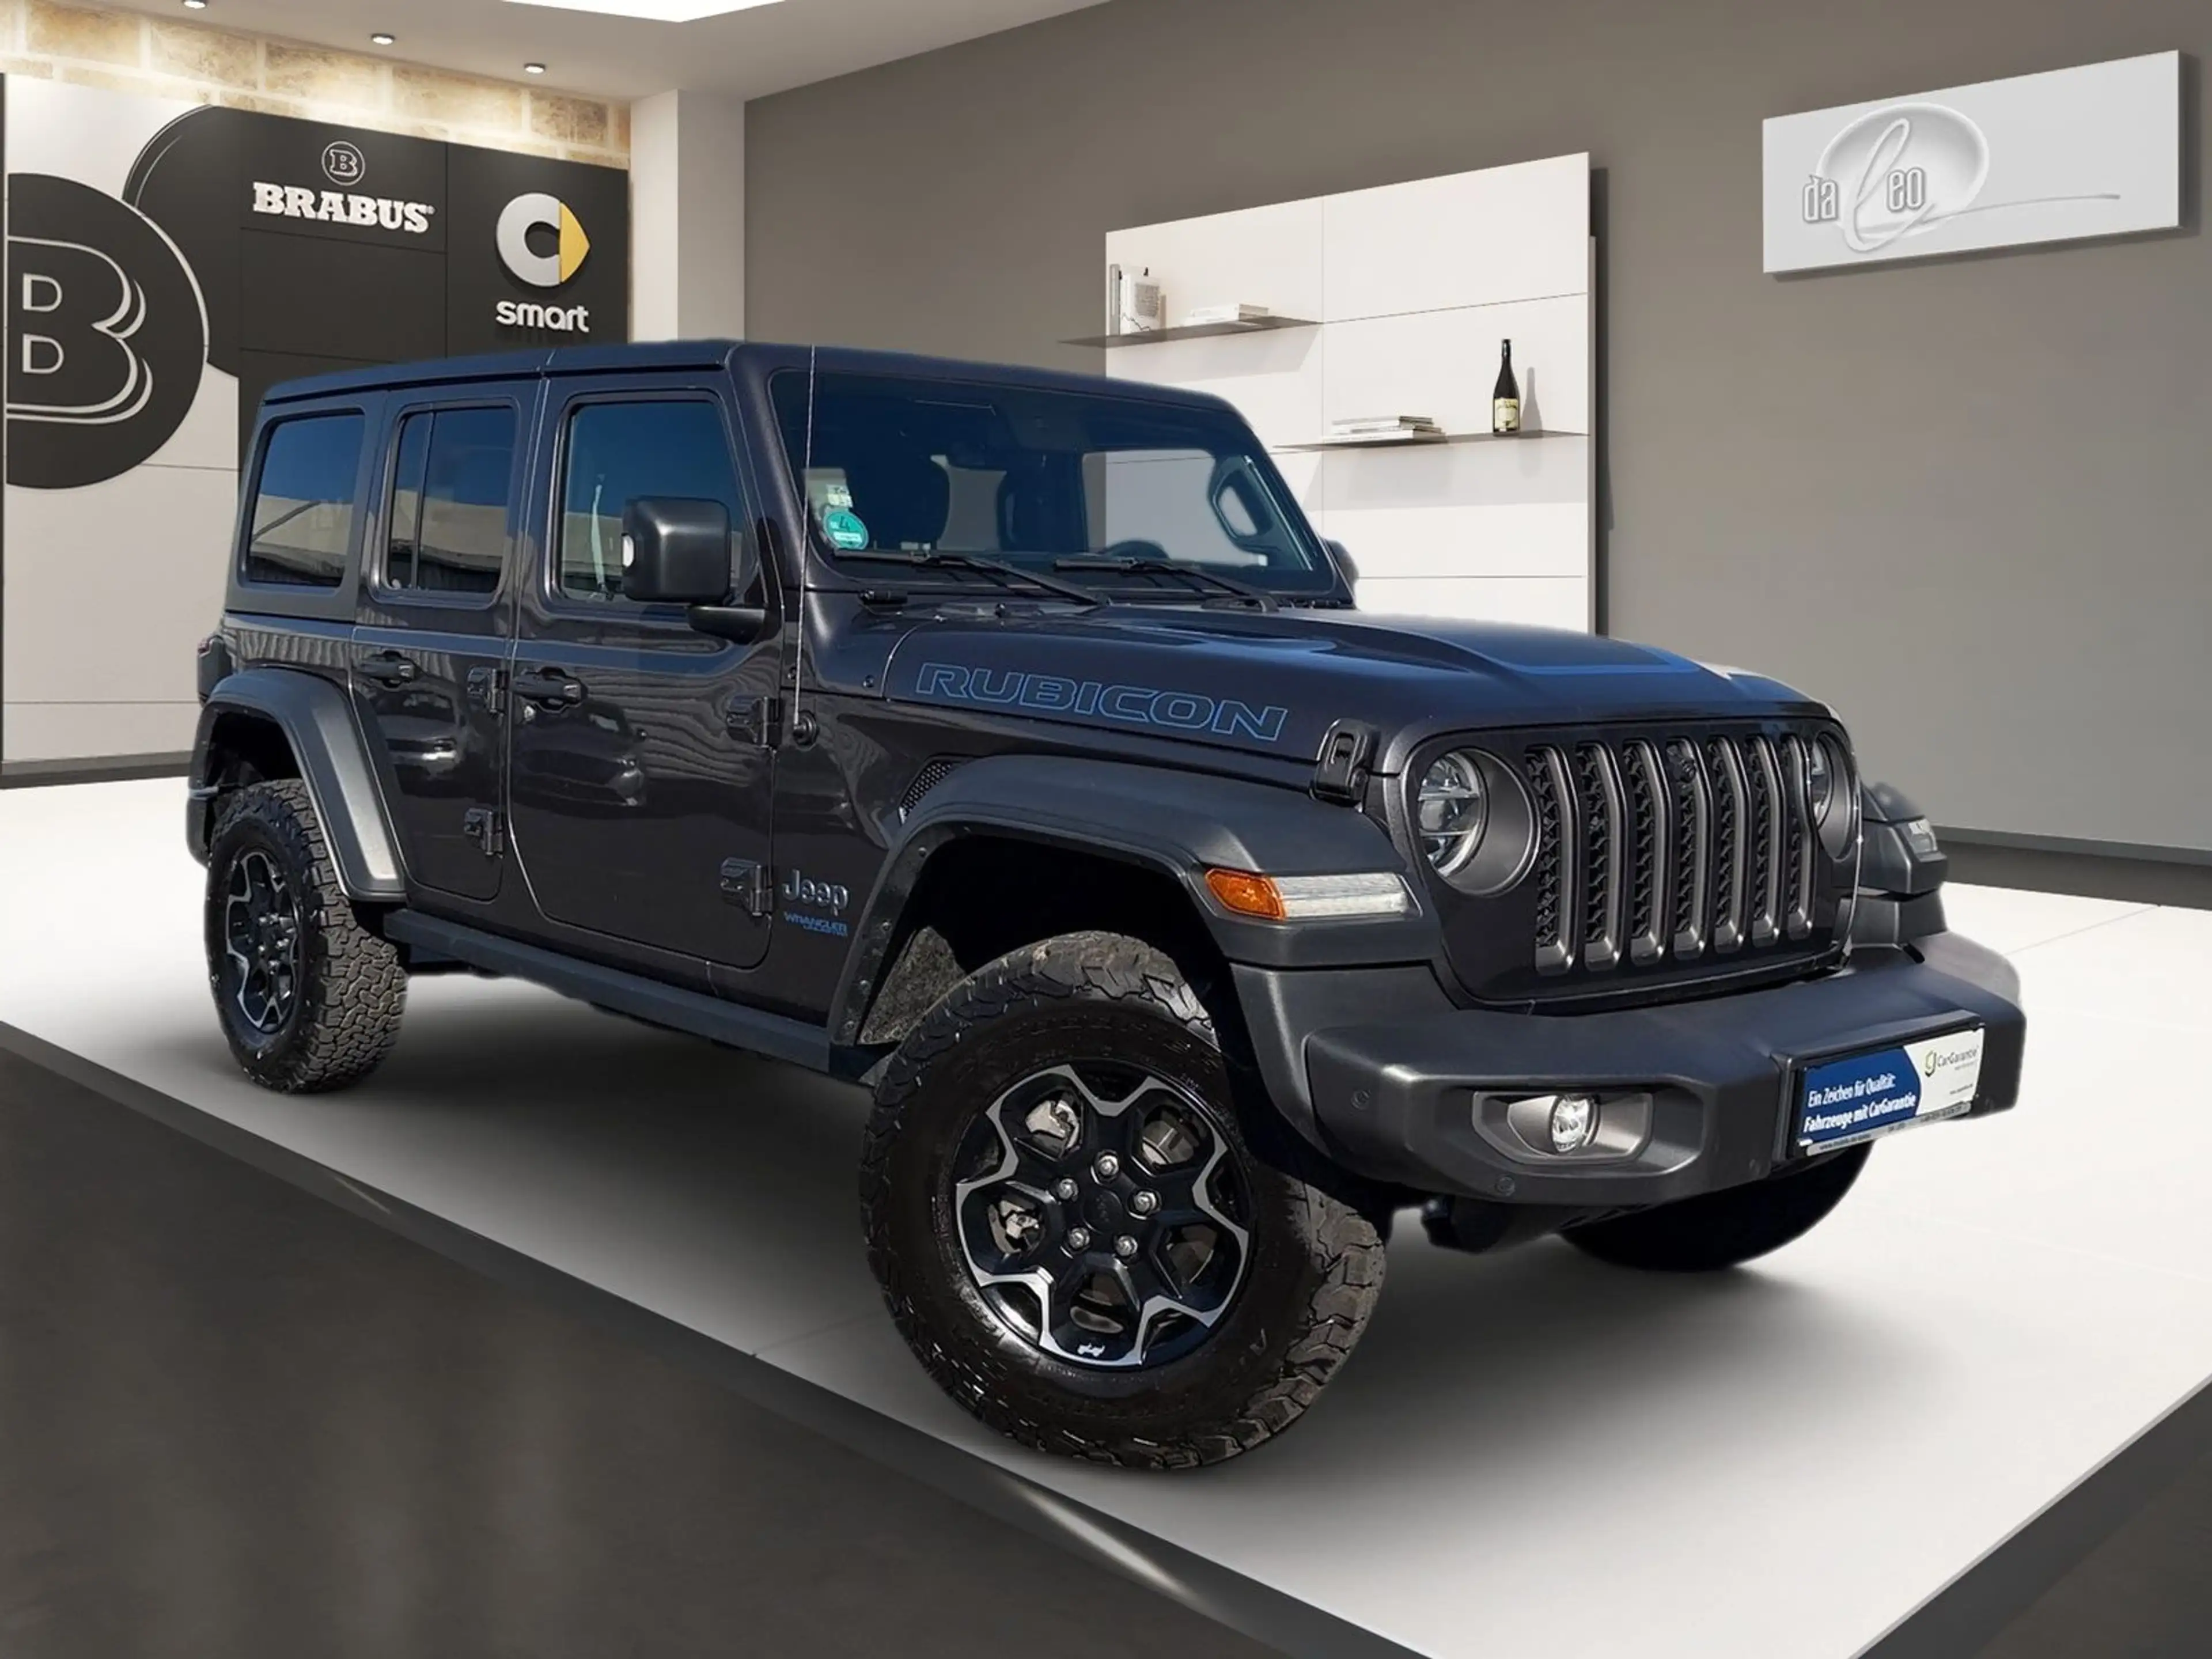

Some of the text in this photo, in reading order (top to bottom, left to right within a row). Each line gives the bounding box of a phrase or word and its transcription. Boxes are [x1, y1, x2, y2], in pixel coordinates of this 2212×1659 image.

[252, 181, 433, 234] BRABUS
[495, 300, 590, 332] smart
[915, 662, 1287, 742] RUBICON
[782, 869, 849, 916] Jeep
[784, 911, 847, 933] WRANGLER
[1803, 1109, 1853, 1133] Fahrzeuge
[1853, 1103, 1869, 1122] mit
[1868, 1092, 1916, 1118] CarGarantie
[1807, 1090, 1822, 1108] Ein
[1822, 1084, 1853, 1105] Zeichen
[1854, 1080, 1866, 1096] für
